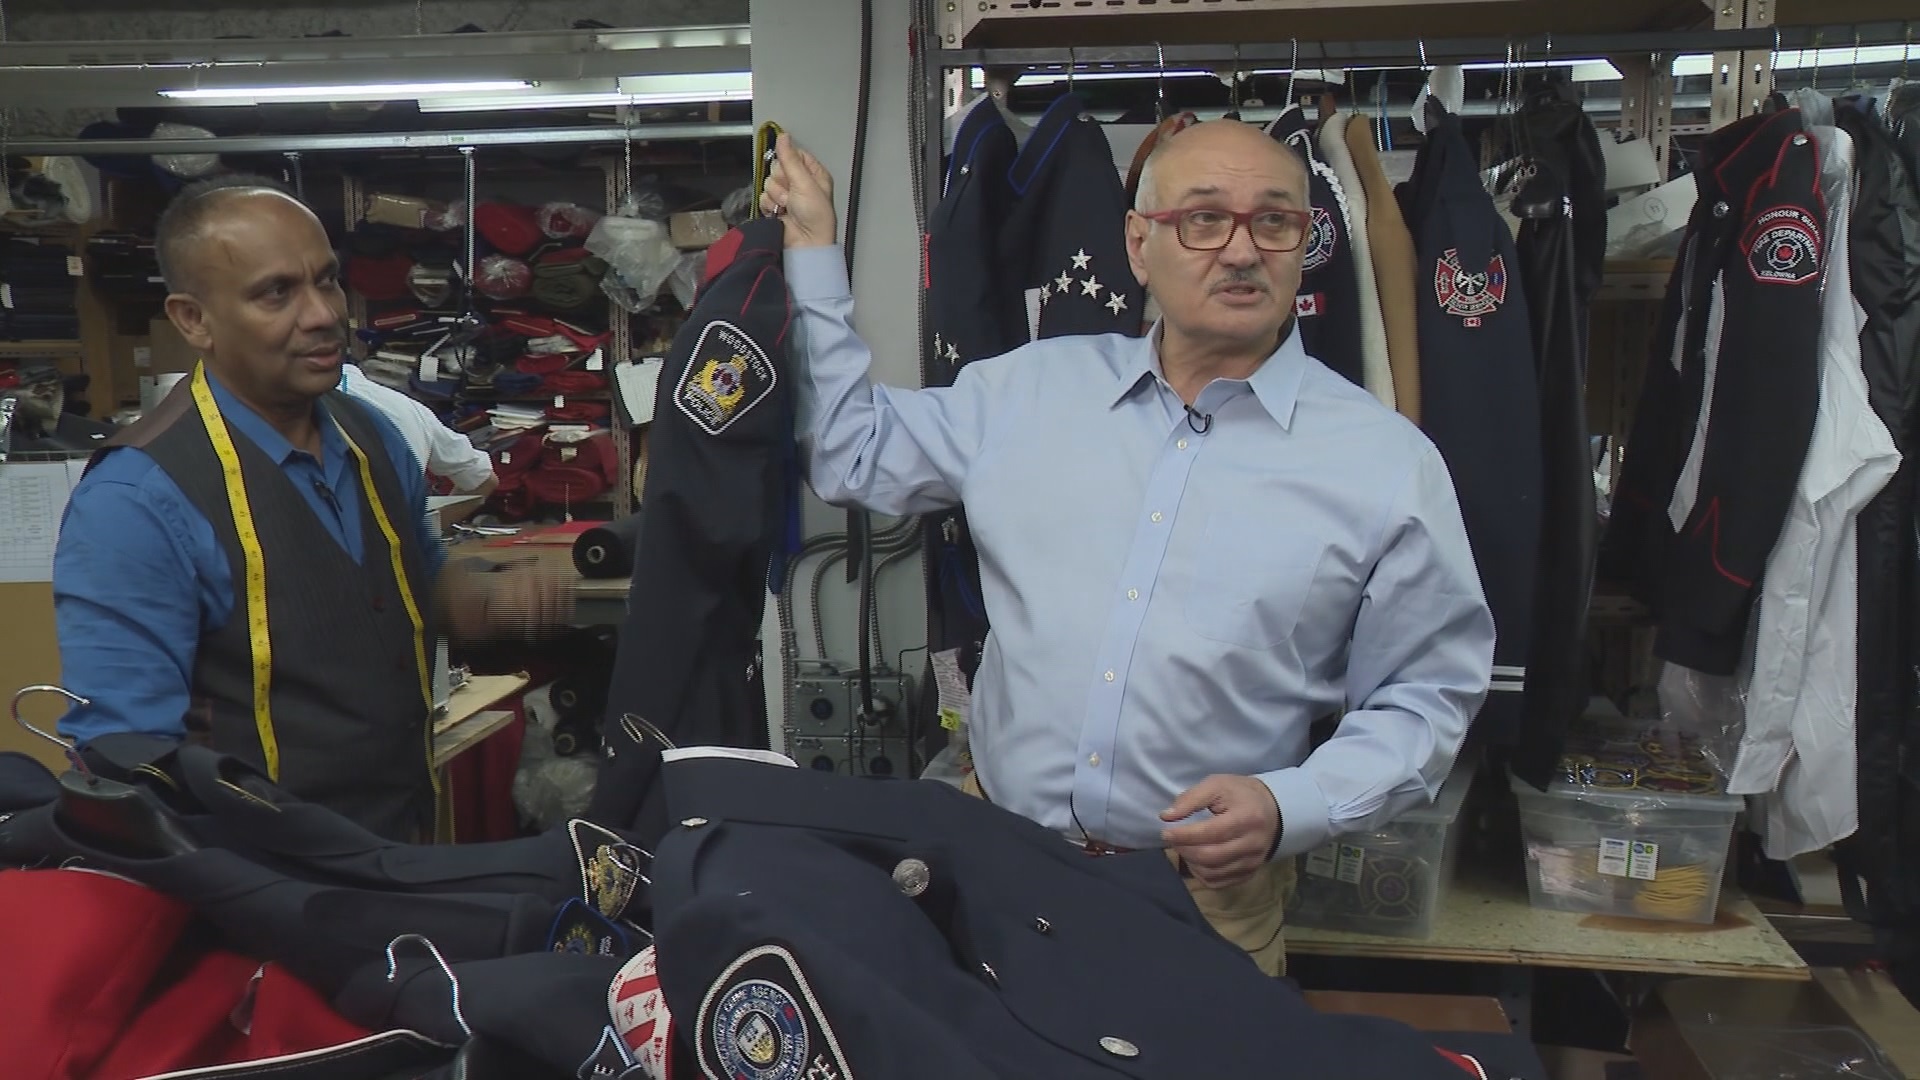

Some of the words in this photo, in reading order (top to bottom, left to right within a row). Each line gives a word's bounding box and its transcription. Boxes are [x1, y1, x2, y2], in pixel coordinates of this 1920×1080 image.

[1757, 209, 1800, 226] HONOUR
[1760, 270, 1797, 279] KELOWNA
[719, 329, 768, 382] WOODSTOCK
[683, 392, 719, 427] POLICE
[751, 985, 789, 1005] AGENCY
